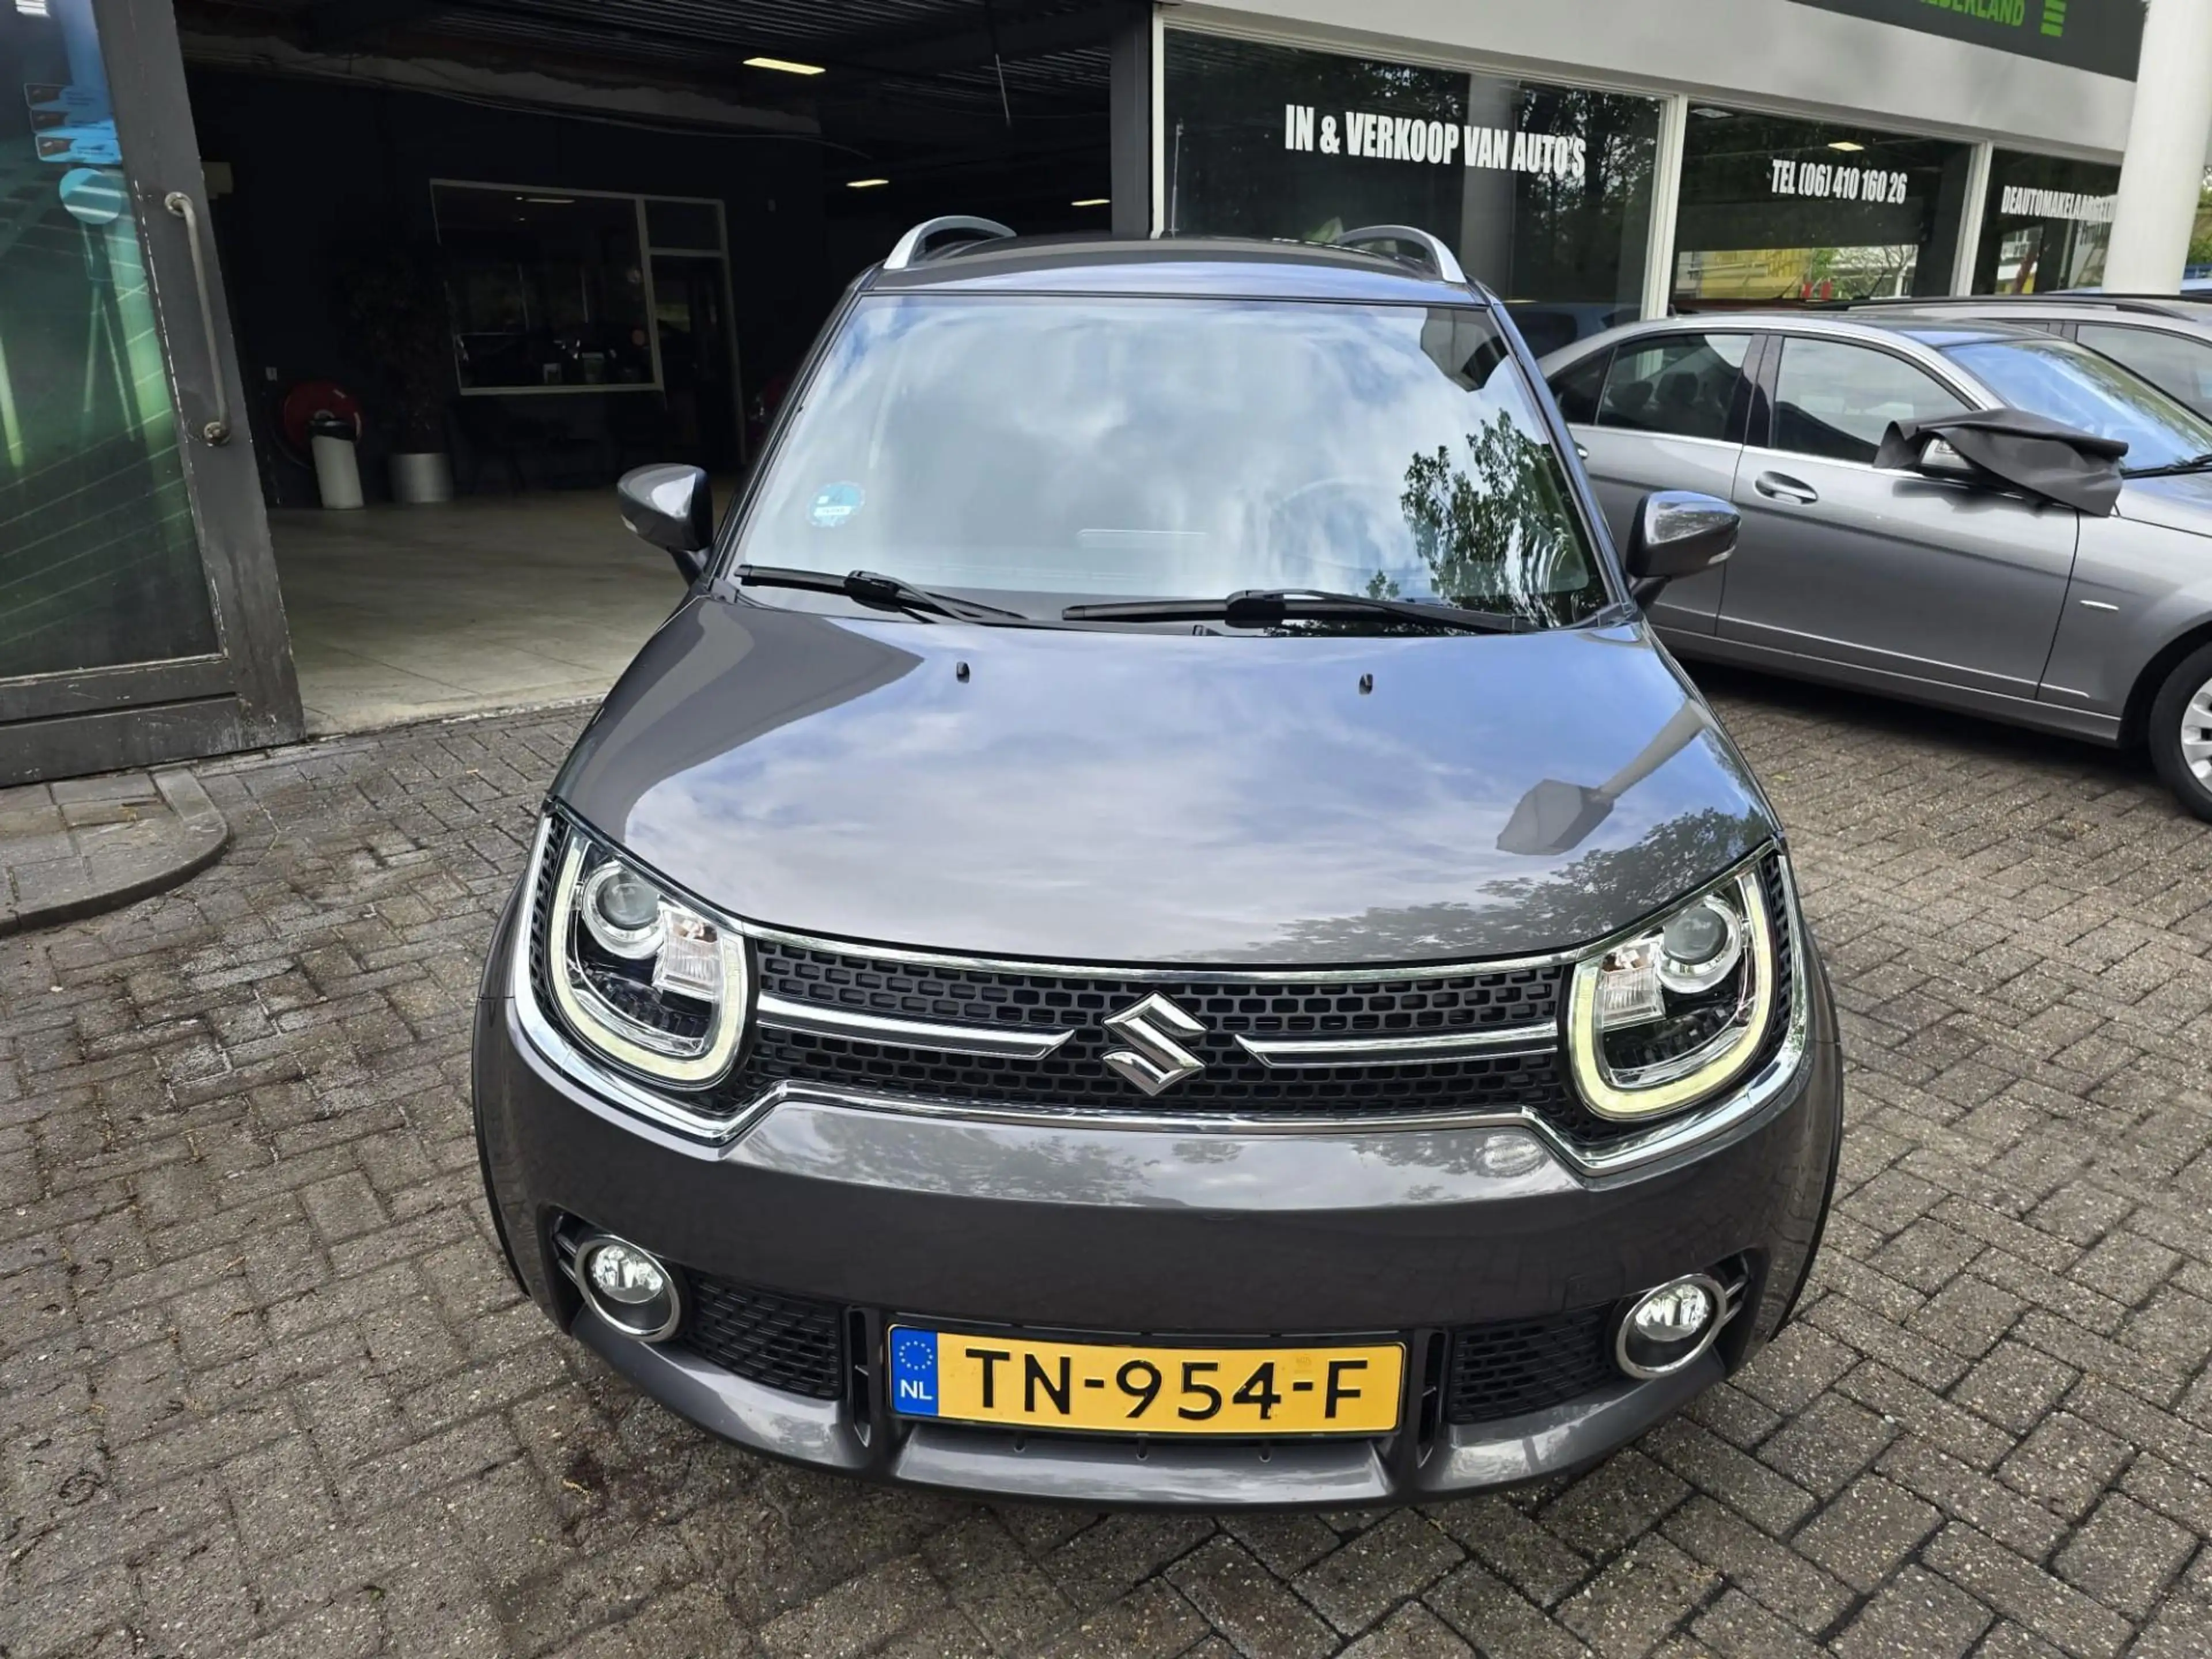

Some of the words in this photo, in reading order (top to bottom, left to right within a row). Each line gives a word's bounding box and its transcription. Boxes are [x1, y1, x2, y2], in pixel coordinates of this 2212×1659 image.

[1285, 104, 1315, 151] IN
[1319, 116, 1340, 154] &
[1345, 111, 1459, 165] VERKOOP
[1463, 125, 1509, 170] VAN
[1511, 131, 1586, 176] AUTO'S
[1771, 159, 1796, 194] TEL
[1798, 162, 1832, 197] (06)
[1832, 165, 1860, 200] 410
[1861, 169, 1888, 202] 160
[1887, 172, 1908, 204] 26
[900, 1379, 934, 1400] NL
[965, 1347, 1368, 1420] TN-954-F
